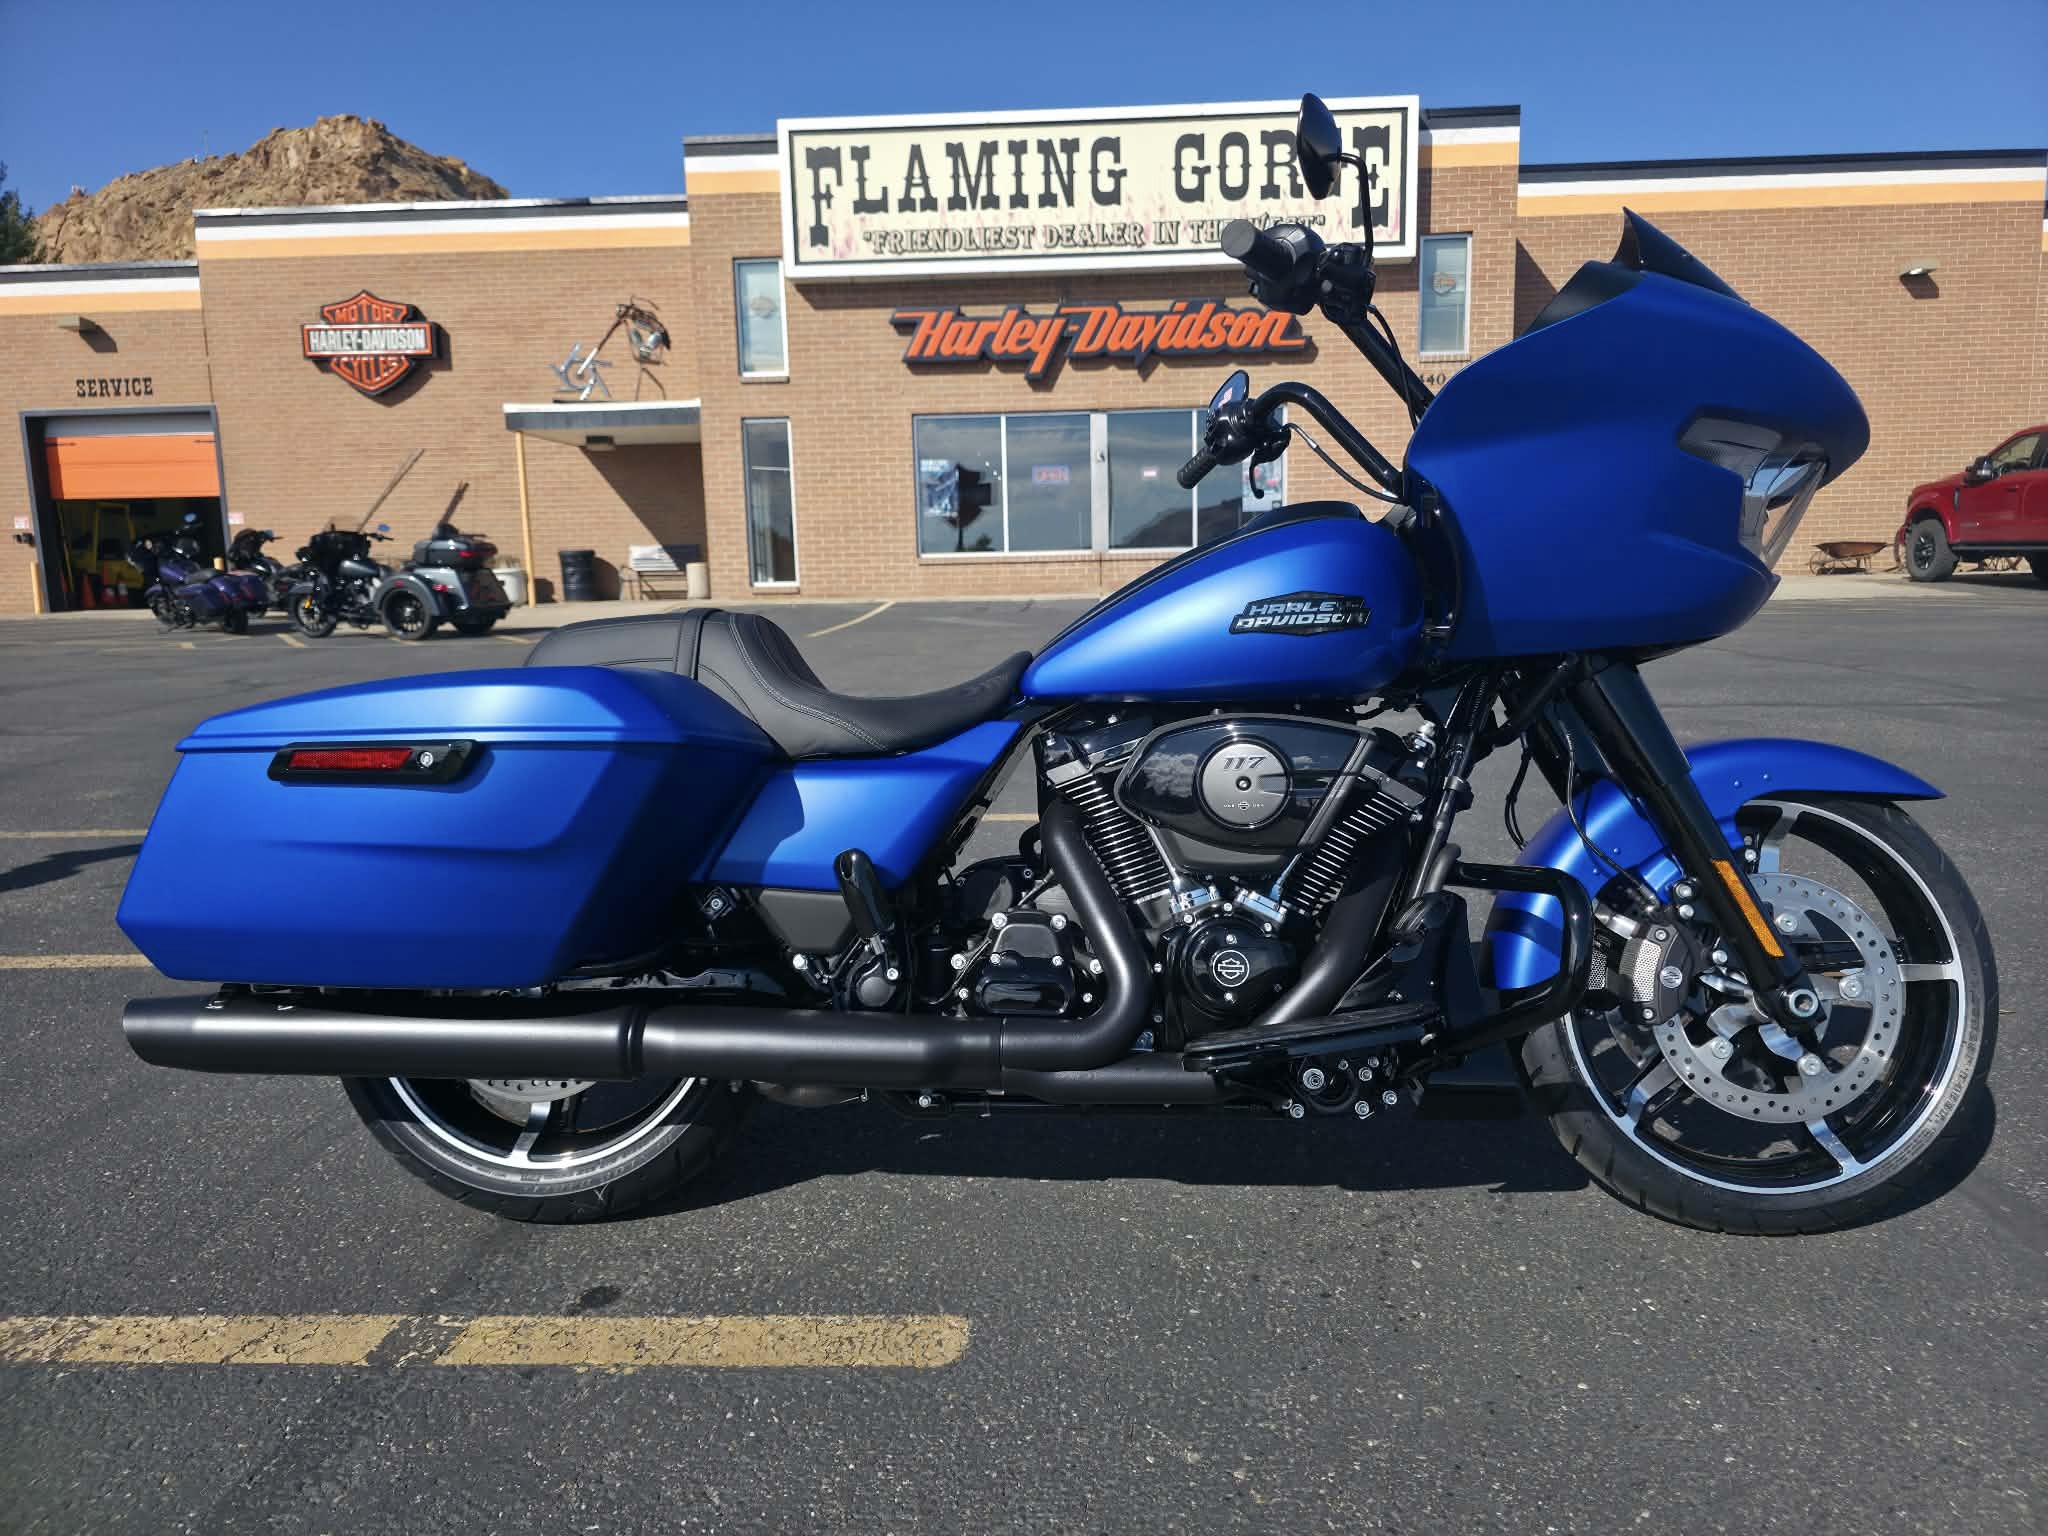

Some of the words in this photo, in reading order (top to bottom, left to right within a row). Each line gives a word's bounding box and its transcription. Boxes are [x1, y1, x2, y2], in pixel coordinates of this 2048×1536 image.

[805, 136, 1128, 248] FLAMING
[1172, 124, 1391, 228] GORE
[863, 219, 1036, 254] "FRIENDLIEST
[1043, 222, 1145, 250] DEALER
[1152, 219, 1180, 245] IN
[335, 299, 396, 323] MOTOR
[309, 327, 427, 352] HARLEY-DAVIDSON
[893, 302, 1306, 376] Harley-Davidson
[340, 355, 401, 385] CYCLES
[75, 376, 154, 398] SERVICE
[1223, 755, 1267, 770] 117
